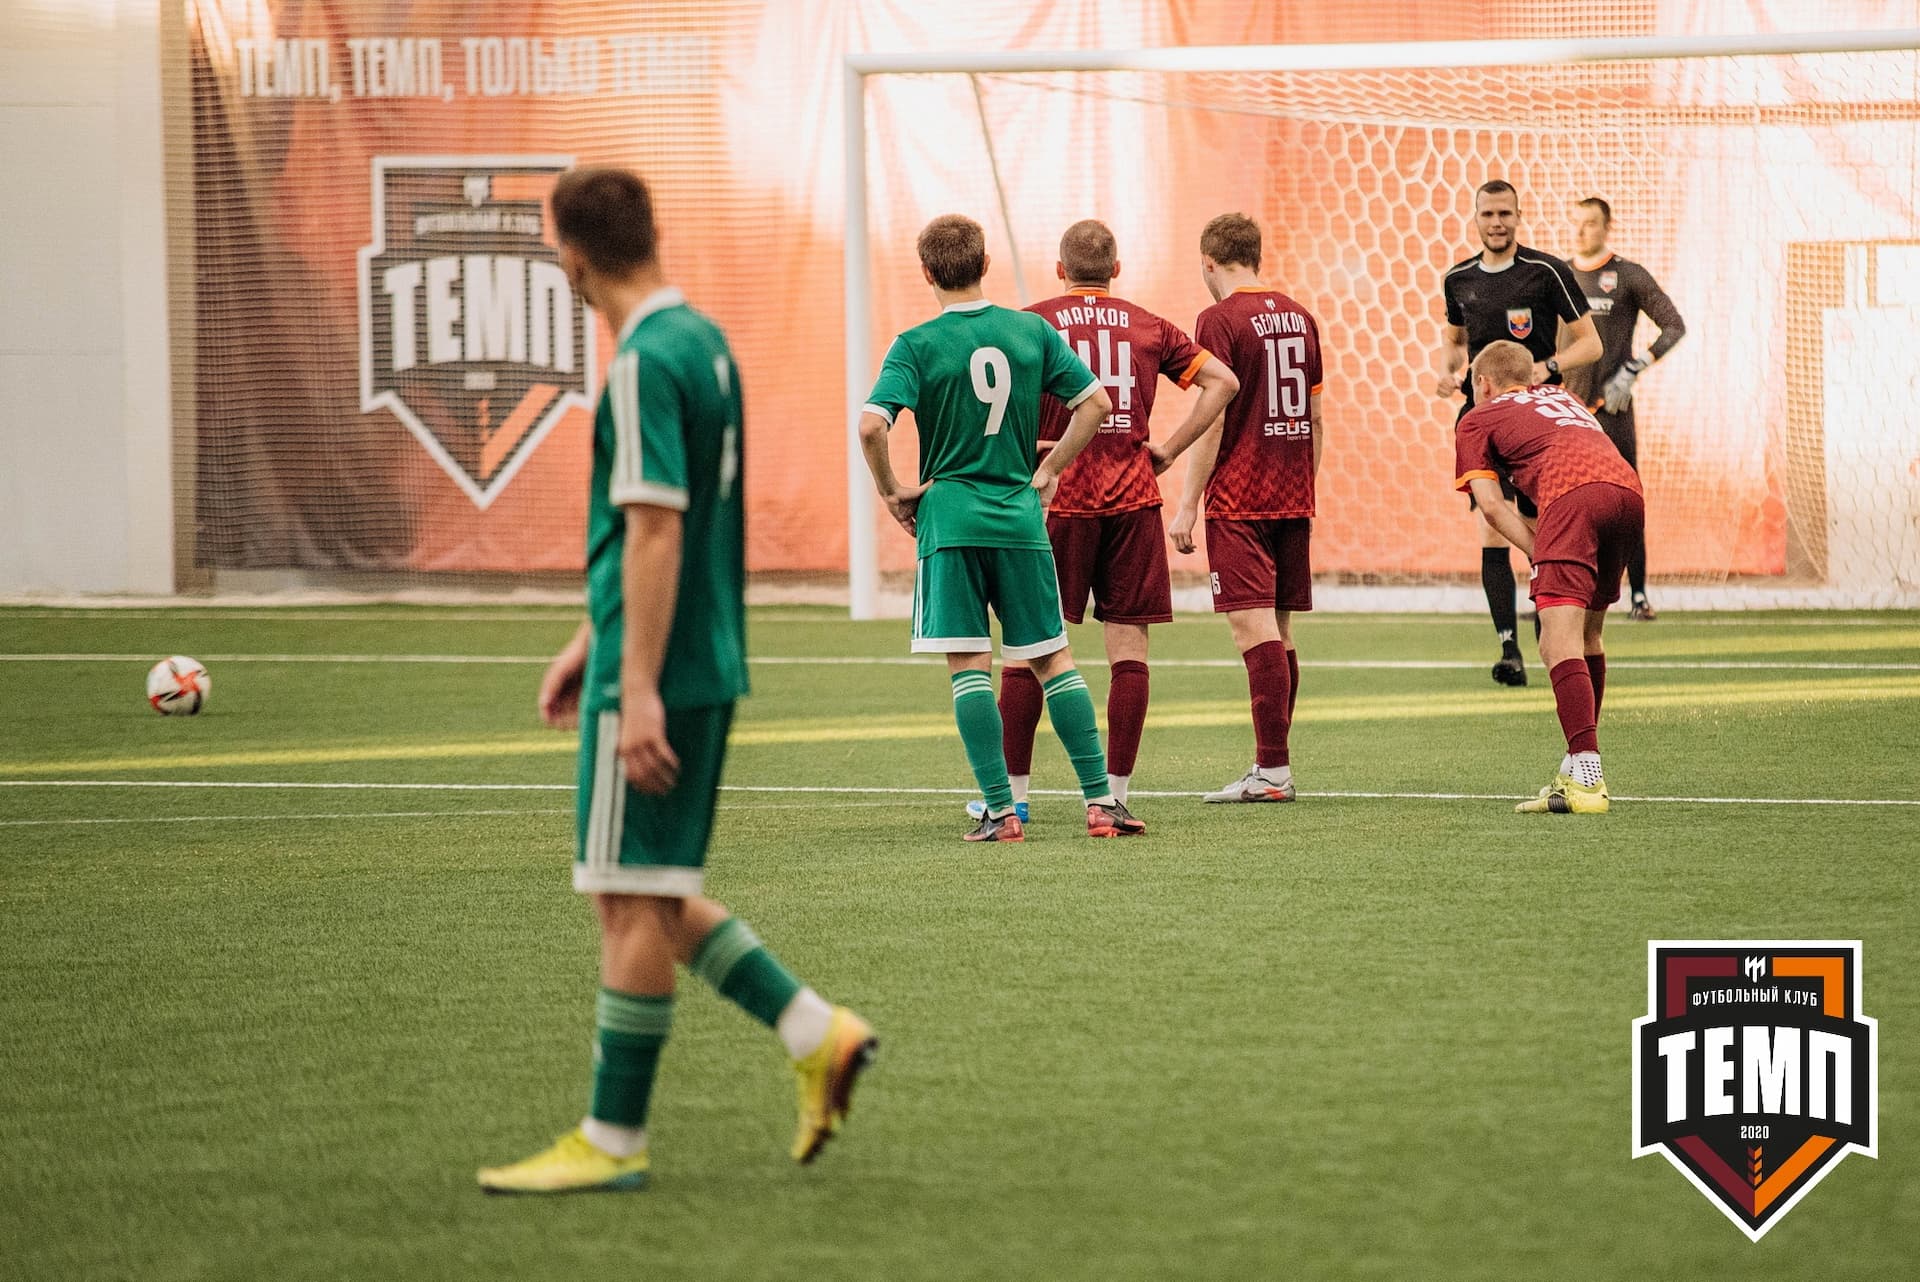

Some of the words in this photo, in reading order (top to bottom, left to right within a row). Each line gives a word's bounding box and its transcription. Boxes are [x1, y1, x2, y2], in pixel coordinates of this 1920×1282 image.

[346, 36, 454, 102] ТЕМП,
[384, 255, 574, 373] ТЕМП
[1055, 306, 1130, 329] МАРКОВ
[1249, 311, 1307, 338] БЕЛИКОВ
[969, 346, 1012, 437] 9
[1264, 336, 1307, 418] 15
[1264, 420, 1311, 437] SEUS
